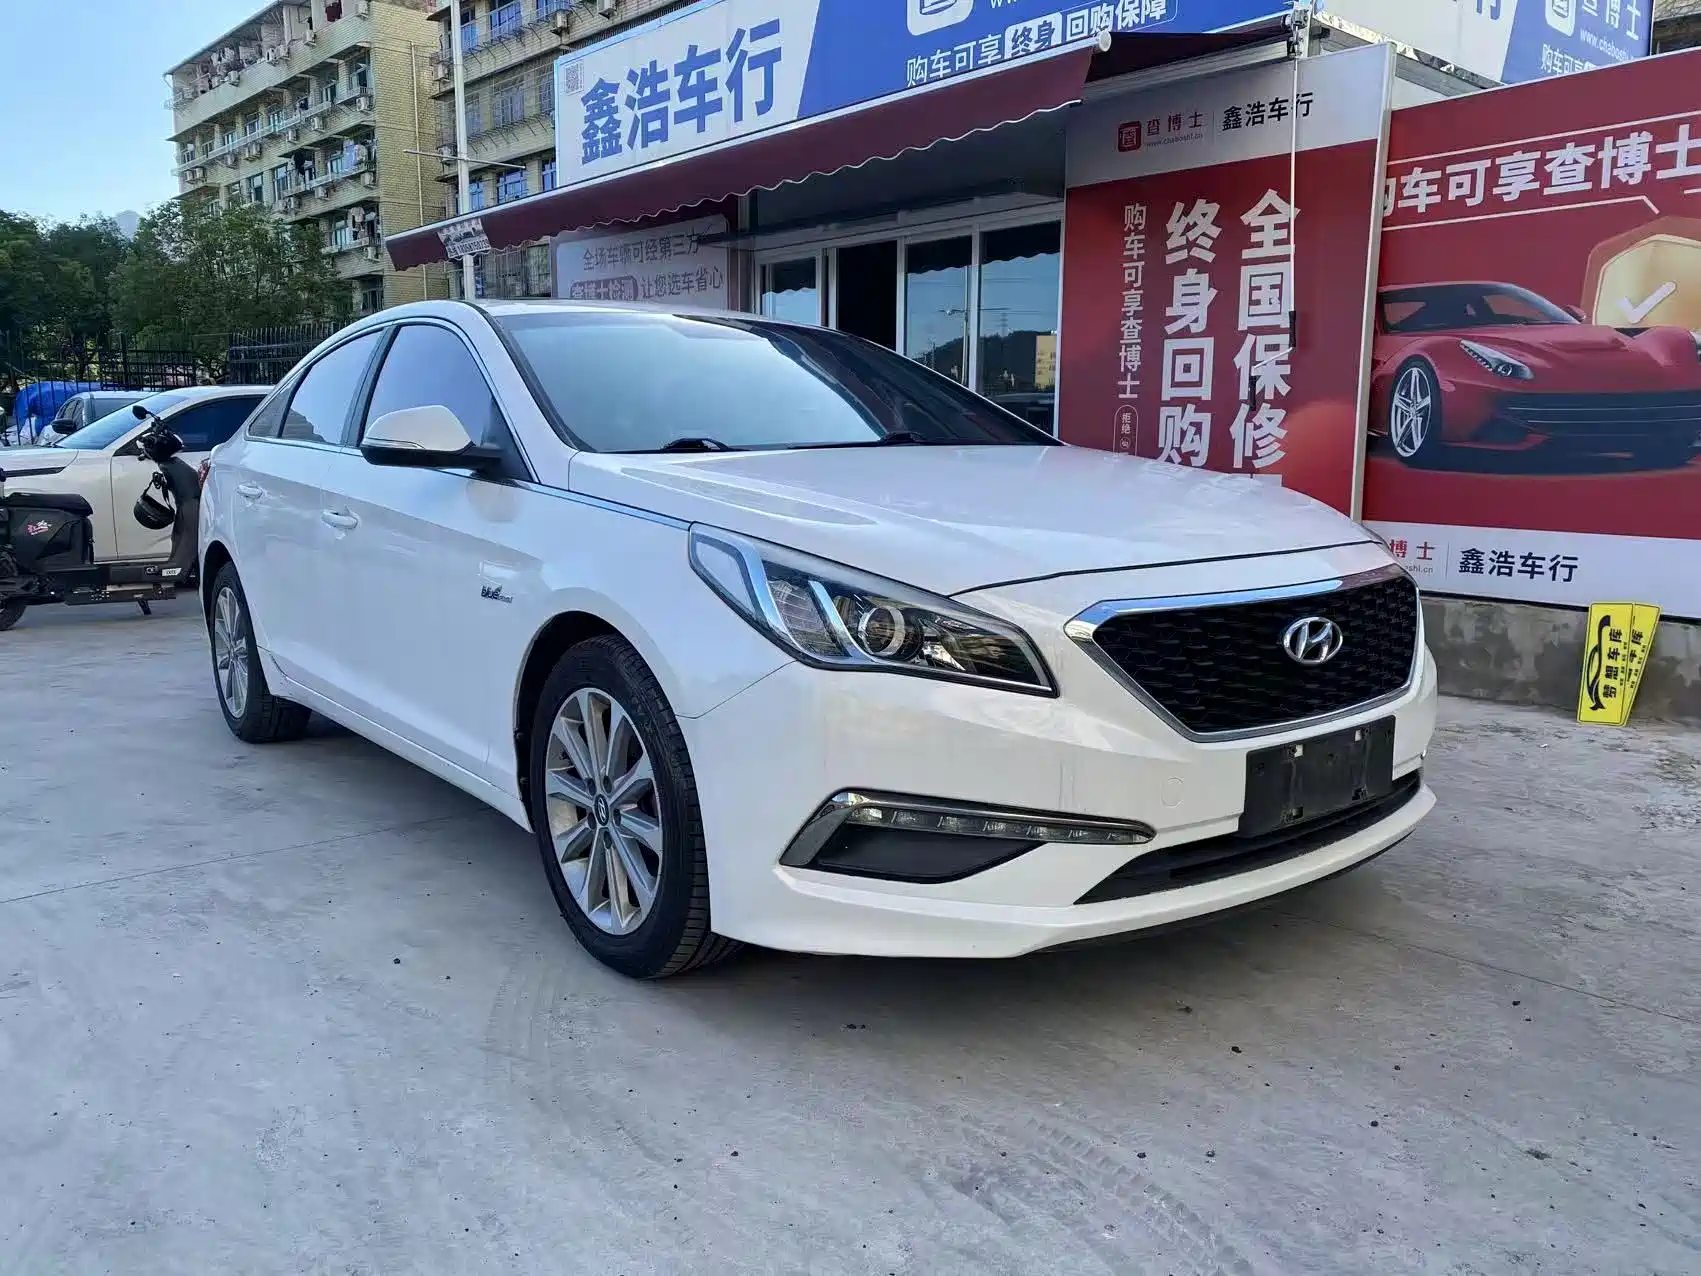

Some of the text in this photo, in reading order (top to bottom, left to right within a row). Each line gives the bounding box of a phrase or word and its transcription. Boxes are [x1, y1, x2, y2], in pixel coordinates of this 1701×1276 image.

[581, 18, 782, 165] 鑫浩车行
[1222, 92, 1314, 132] 鑫浩车行
[1117, 202, 1147, 400] 购车可享查博士
[1158, 198, 1222, 468] 终身回购
[1229, 188, 1301, 469] 全国保修
[1458, 547, 1579, 583] 鑫浩车行
